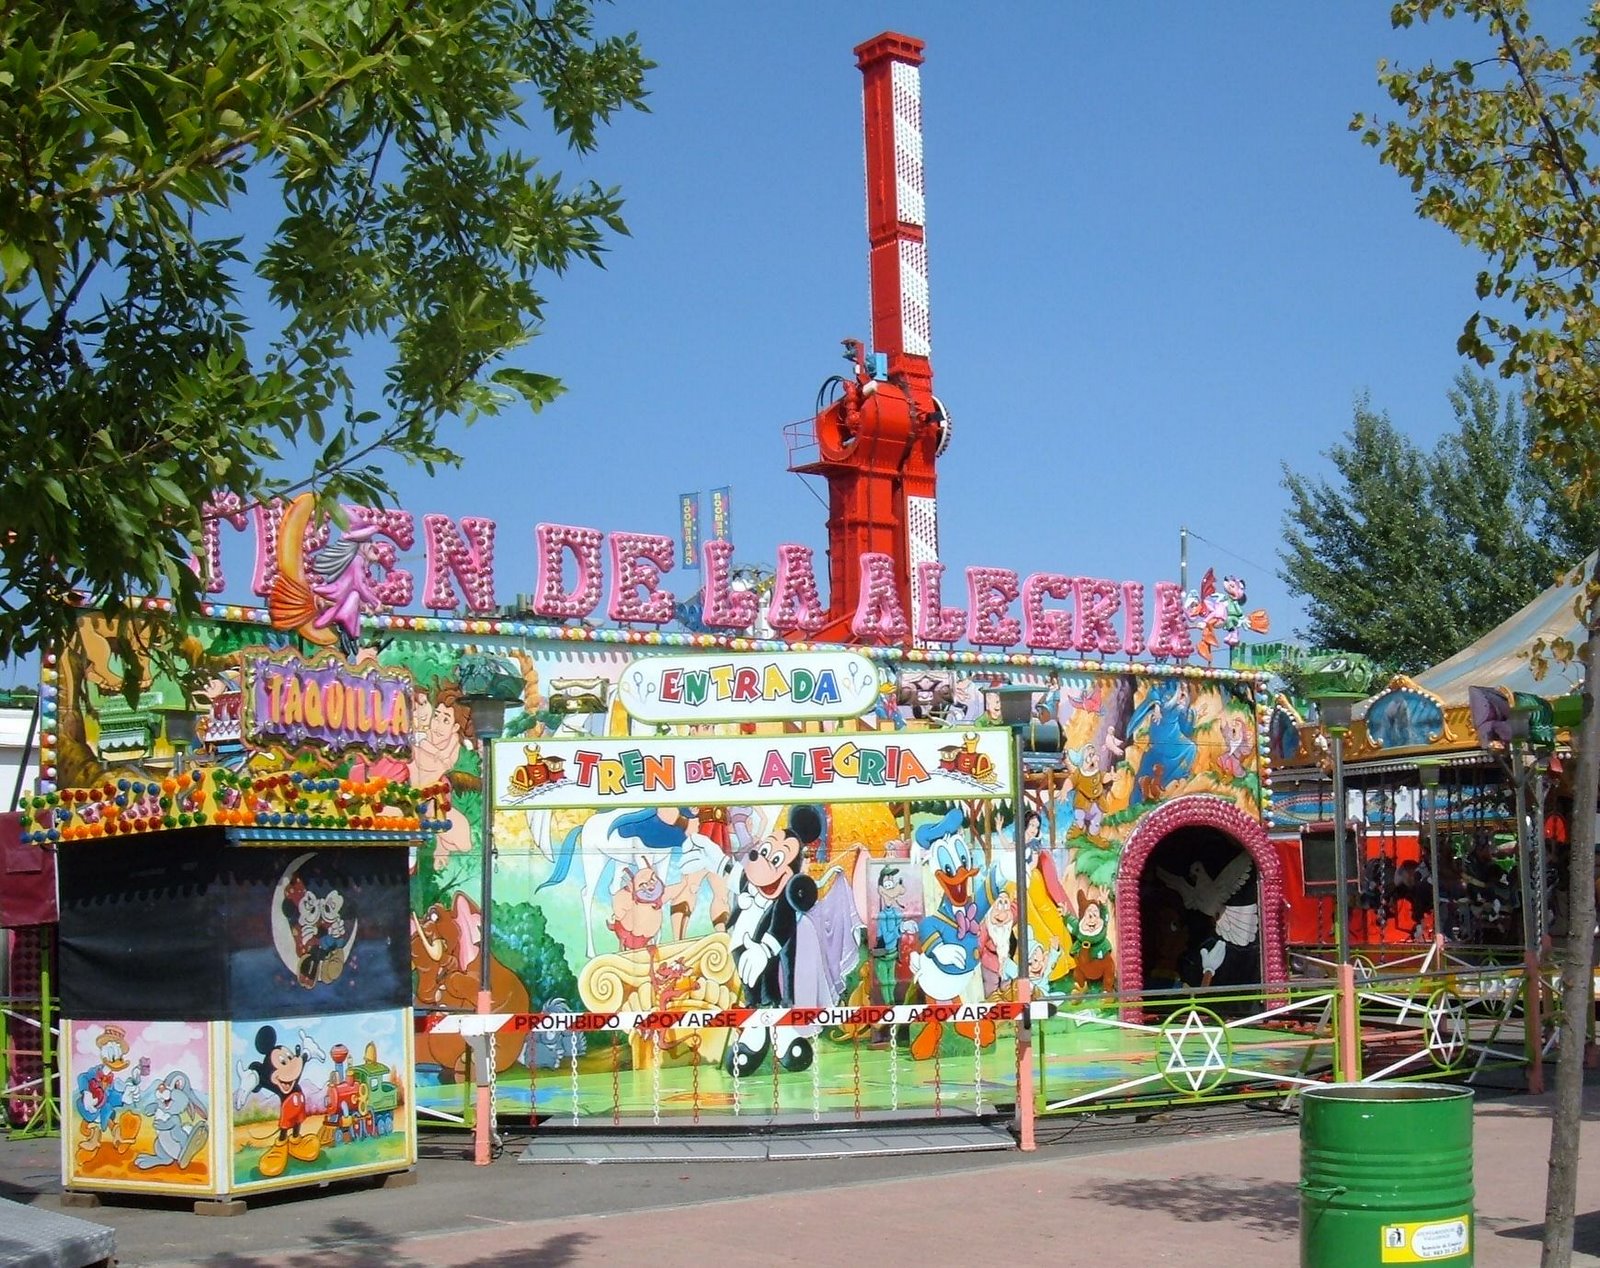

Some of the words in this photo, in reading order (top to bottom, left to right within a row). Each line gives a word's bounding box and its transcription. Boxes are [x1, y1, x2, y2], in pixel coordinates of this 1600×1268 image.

[533, 522, 675, 625] DE
[702, 540, 828, 632] LA
[852, 552, 1195, 658] ALEGRIA
[264, 671, 409, 736] TAQUILLA
[658, 663, 843, 706] ENTRADA
[574, 749, 676, 795] TREN
[684, 757, 714, 784] DE
[714, 762, 752, 786] LA
[758, 741, 931, 789] ALEGRIA
[514, 1013, 620, 1031] PROHIBIDO
[632, 1012, 737, 1029] APOYARSE
[791, 1007, 895, 1025] PROHIBIDO
[907, 1005, 1012, 1023] APOYARSE
